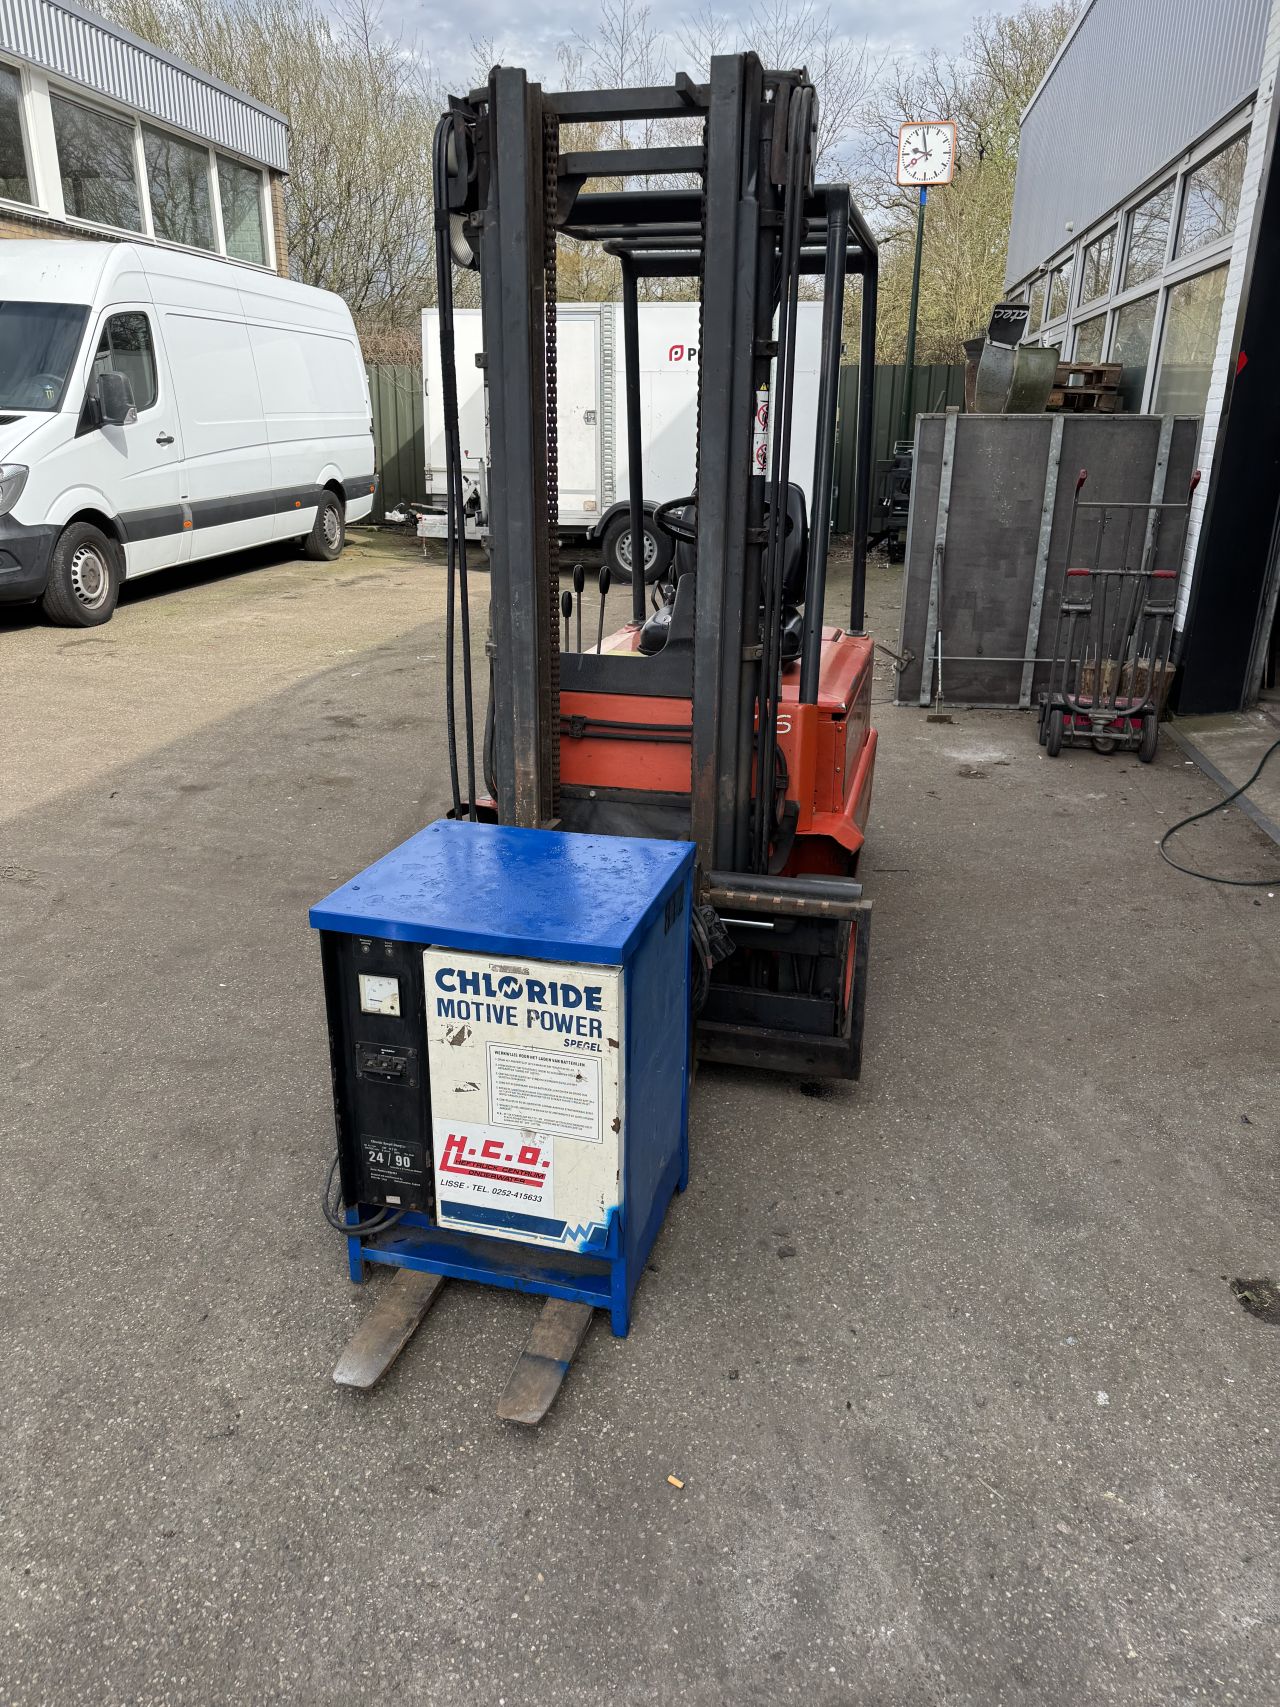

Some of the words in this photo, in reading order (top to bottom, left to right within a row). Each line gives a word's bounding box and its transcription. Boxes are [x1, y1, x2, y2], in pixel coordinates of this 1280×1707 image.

[435, 967, 602, 1012] CHLORIDE
[437, 997, 519, 1027] MOTIVE
[527, 1008, 602, 1039] POWER
[563, 1038, 603, 1053] SPEGEL
[368, 1150, 384, 1164] 24
[395, 1155, 411, 1168] 90
[455, 1159, 498, 1172] HEFTRUCK
[501, 1166, 545, 1179] CENTRUM
[468, 1169, 526, 1184] ONDERWATER
[440, 1178, 465, 1189] LISSE
[472, 1184, 490, 1194] TEL.
[491, 1187, 543, 1203] 0252-415633
